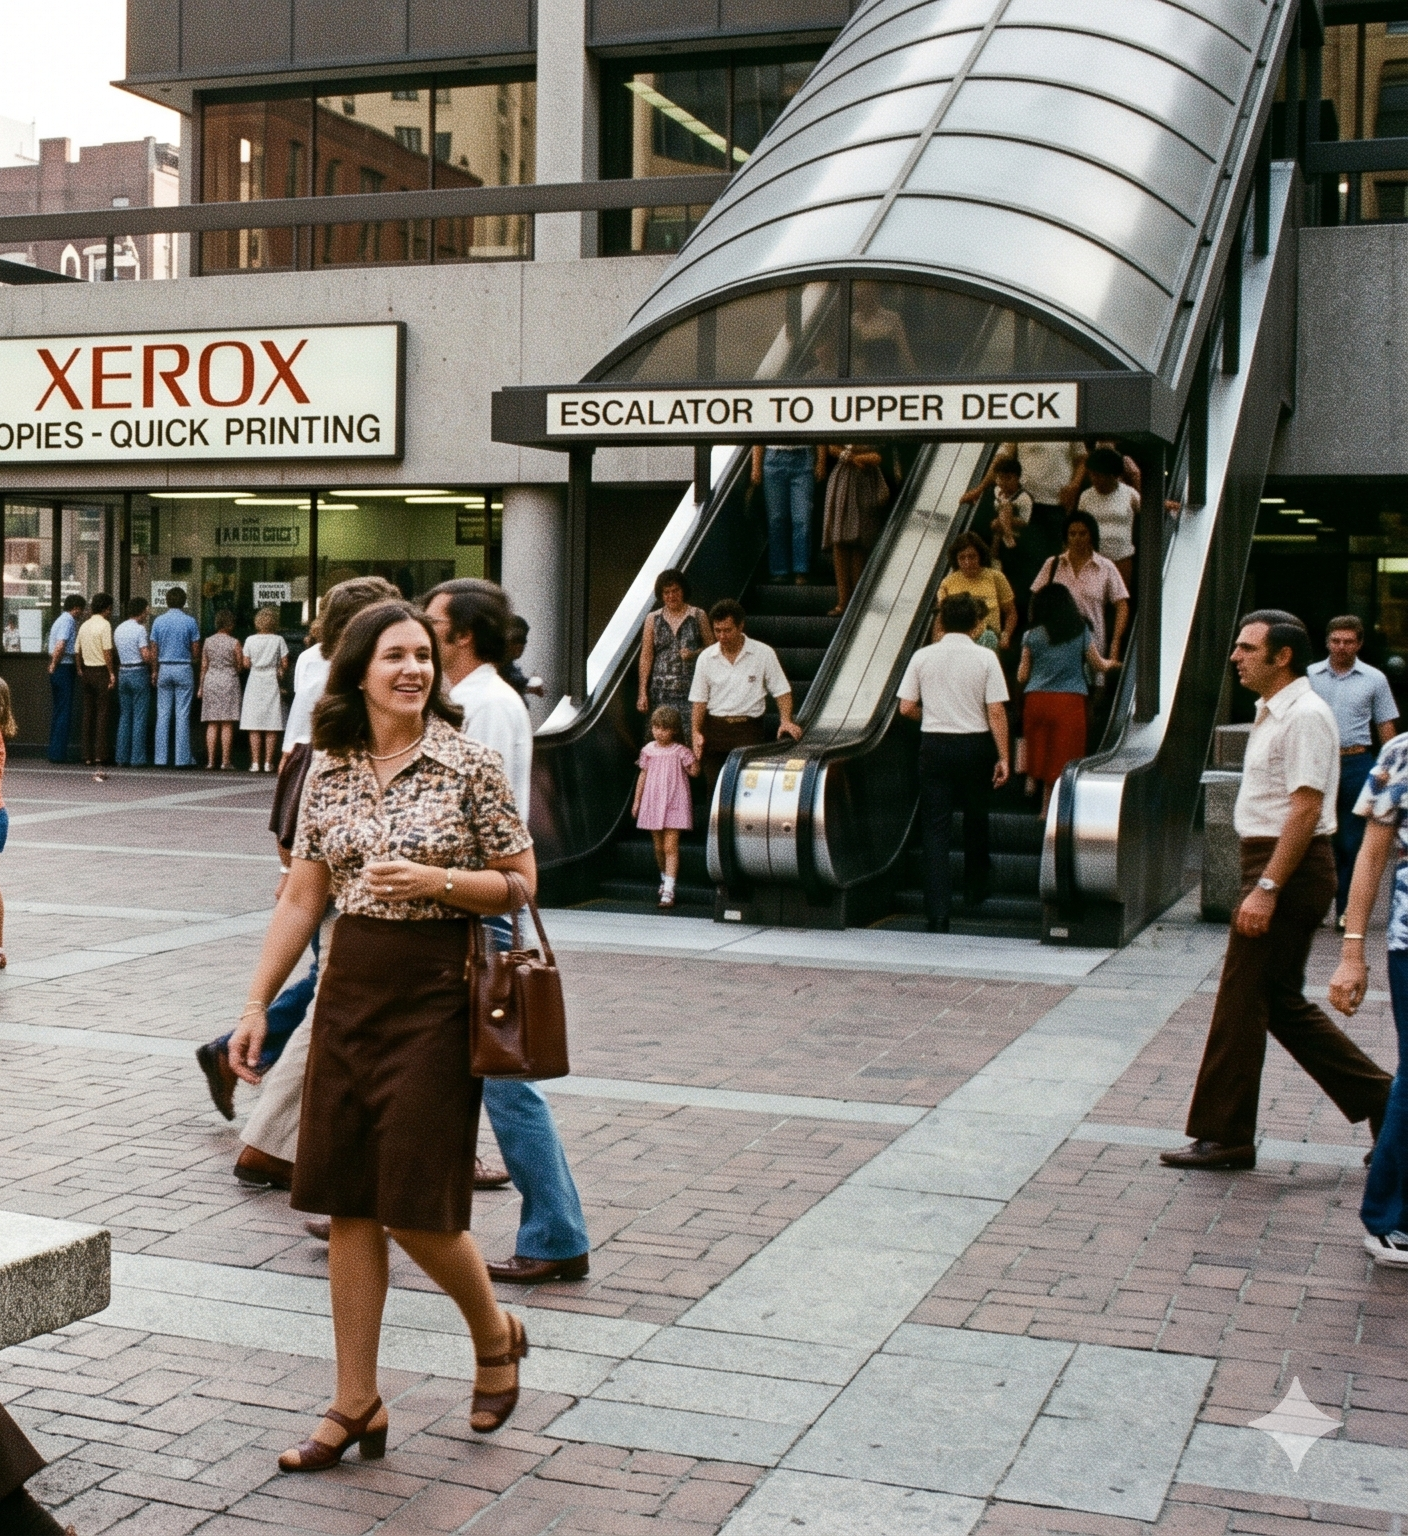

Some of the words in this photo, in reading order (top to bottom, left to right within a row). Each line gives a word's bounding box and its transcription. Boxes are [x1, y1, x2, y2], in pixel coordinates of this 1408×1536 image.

[34, 338, 311, 411] XEROX
[560, 398, 753, 427] ESCALATOR
[769, 396, 814, 424] TO
[830, 394, 944, 422] UPPER
[962, 392, 1061, 420] DECK
[109, 418, 210, 448] QUICK
[225, 414, 381, 445] PRINTING
